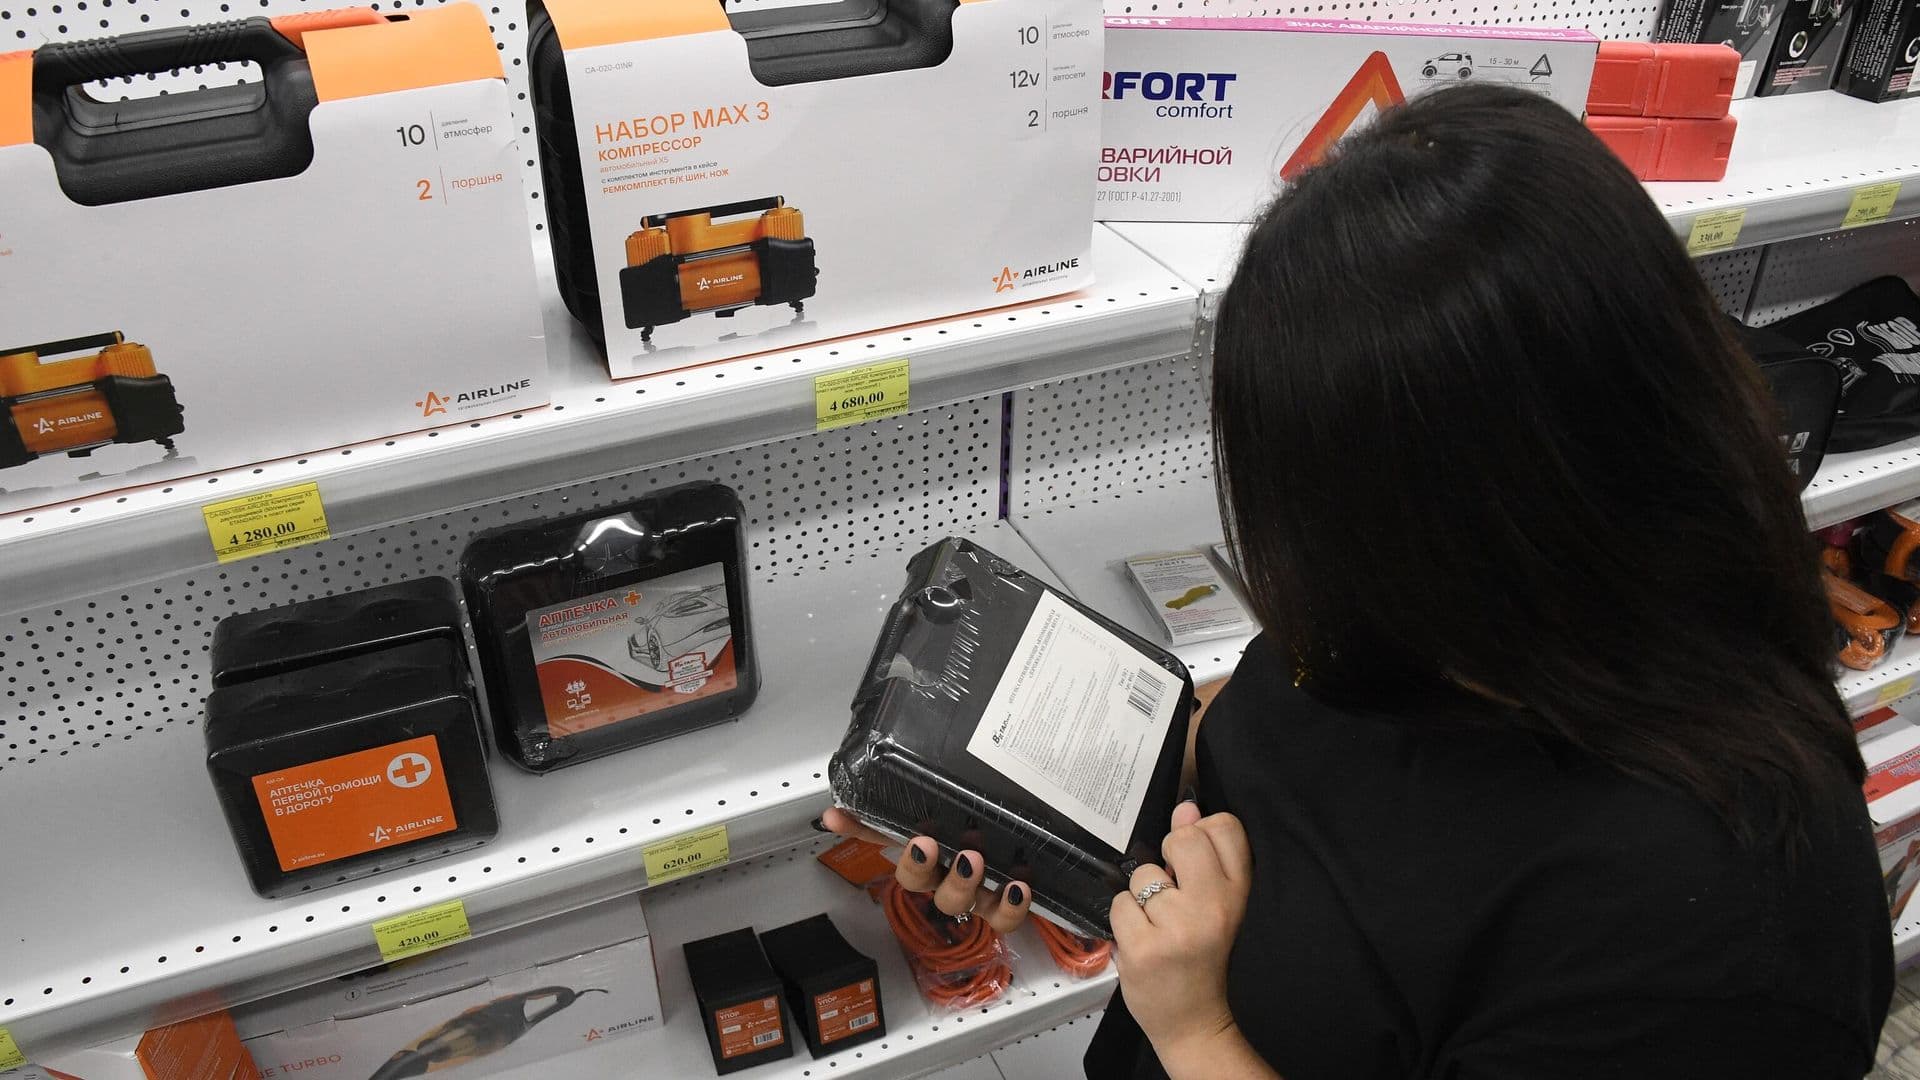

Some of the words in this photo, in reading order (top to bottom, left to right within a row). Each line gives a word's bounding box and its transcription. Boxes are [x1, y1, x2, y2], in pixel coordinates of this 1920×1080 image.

[1018, 26, 1039, 45] 10
[1052, 29, 1090, 40] атмосфер
[1339, 23, 1452, 33] АВАРИЙНОЙ
[1455, 29, 1566, 38] ОСТАНОВКИ
[1504, 58, 1512, 66] 30
[1010, 70, 1040, 88] 12v
[1052, 72, 1086, 82] автосети
[1028, 110, 1038, 127] 2
[1052, 106, 1088, 119] поршня
[1156, 103, 1233, 118] comfort
[595, 112, 685, 145] НАБОР
[756, 101, 770, 121] 3
[396, 124, 425, 147] 10
[444, 125, 493, 139] атмосфер
[598, 136, 702, 162] КОМПРЕССОР
[1099, 146, 1232, 165] ВАРИЙНОЙ
[602, 178, 668, 194] РЕМКОМПЛЕКТ
[670, 176, 684, 186] Б/К
[685, 172, 709, 182] ШИН,
[710, 168, 729, 178] НОЖ
[607, 171, 649, 184] комплектом
[650, 165, 692, 178] инструмента
[698, 161, 718, 170] кейсе
[416, 180, 432, 200] 2
[452, 173, 503, 189] поршня
[1023, 258, 1079, 279] AIRLINE
[713, 274, 744, 284] AIRLINE
[458, 379, 530, 403] AIRLINE
[830, 400, 838, 411] 4
[842, 391, 884, 410] 680.00
[58, 412, 102, 426] AIRLINE
[230, 534, 239, 545] 4
[538, 598, 619, 628] АПТЕЧКА
[542, 612, 629, 642] АВТОМОБИЛЬНАЯ
[270, 778, 325, 798] АПТЕЧКА
[272, 788, 322, 807] ПЕРВОЙ
[324, 774, 382, 796] ПОМОЩИ
[275, 808, 284, 816] В
[286, 796, 334, 815] ДОРОГУ
[396, 815, 444, 833] AIRLINE
[664, 852, 702, 870] 620.00
[398, 930, 439, 947] 420.00
[818, 996, 838, 1006] УПОР
[608, 1016, 654, 1032] AIRLINE
[720, 1010, 740, 1020] УПОР
[279, 1054, 342, 1072] TURBO
